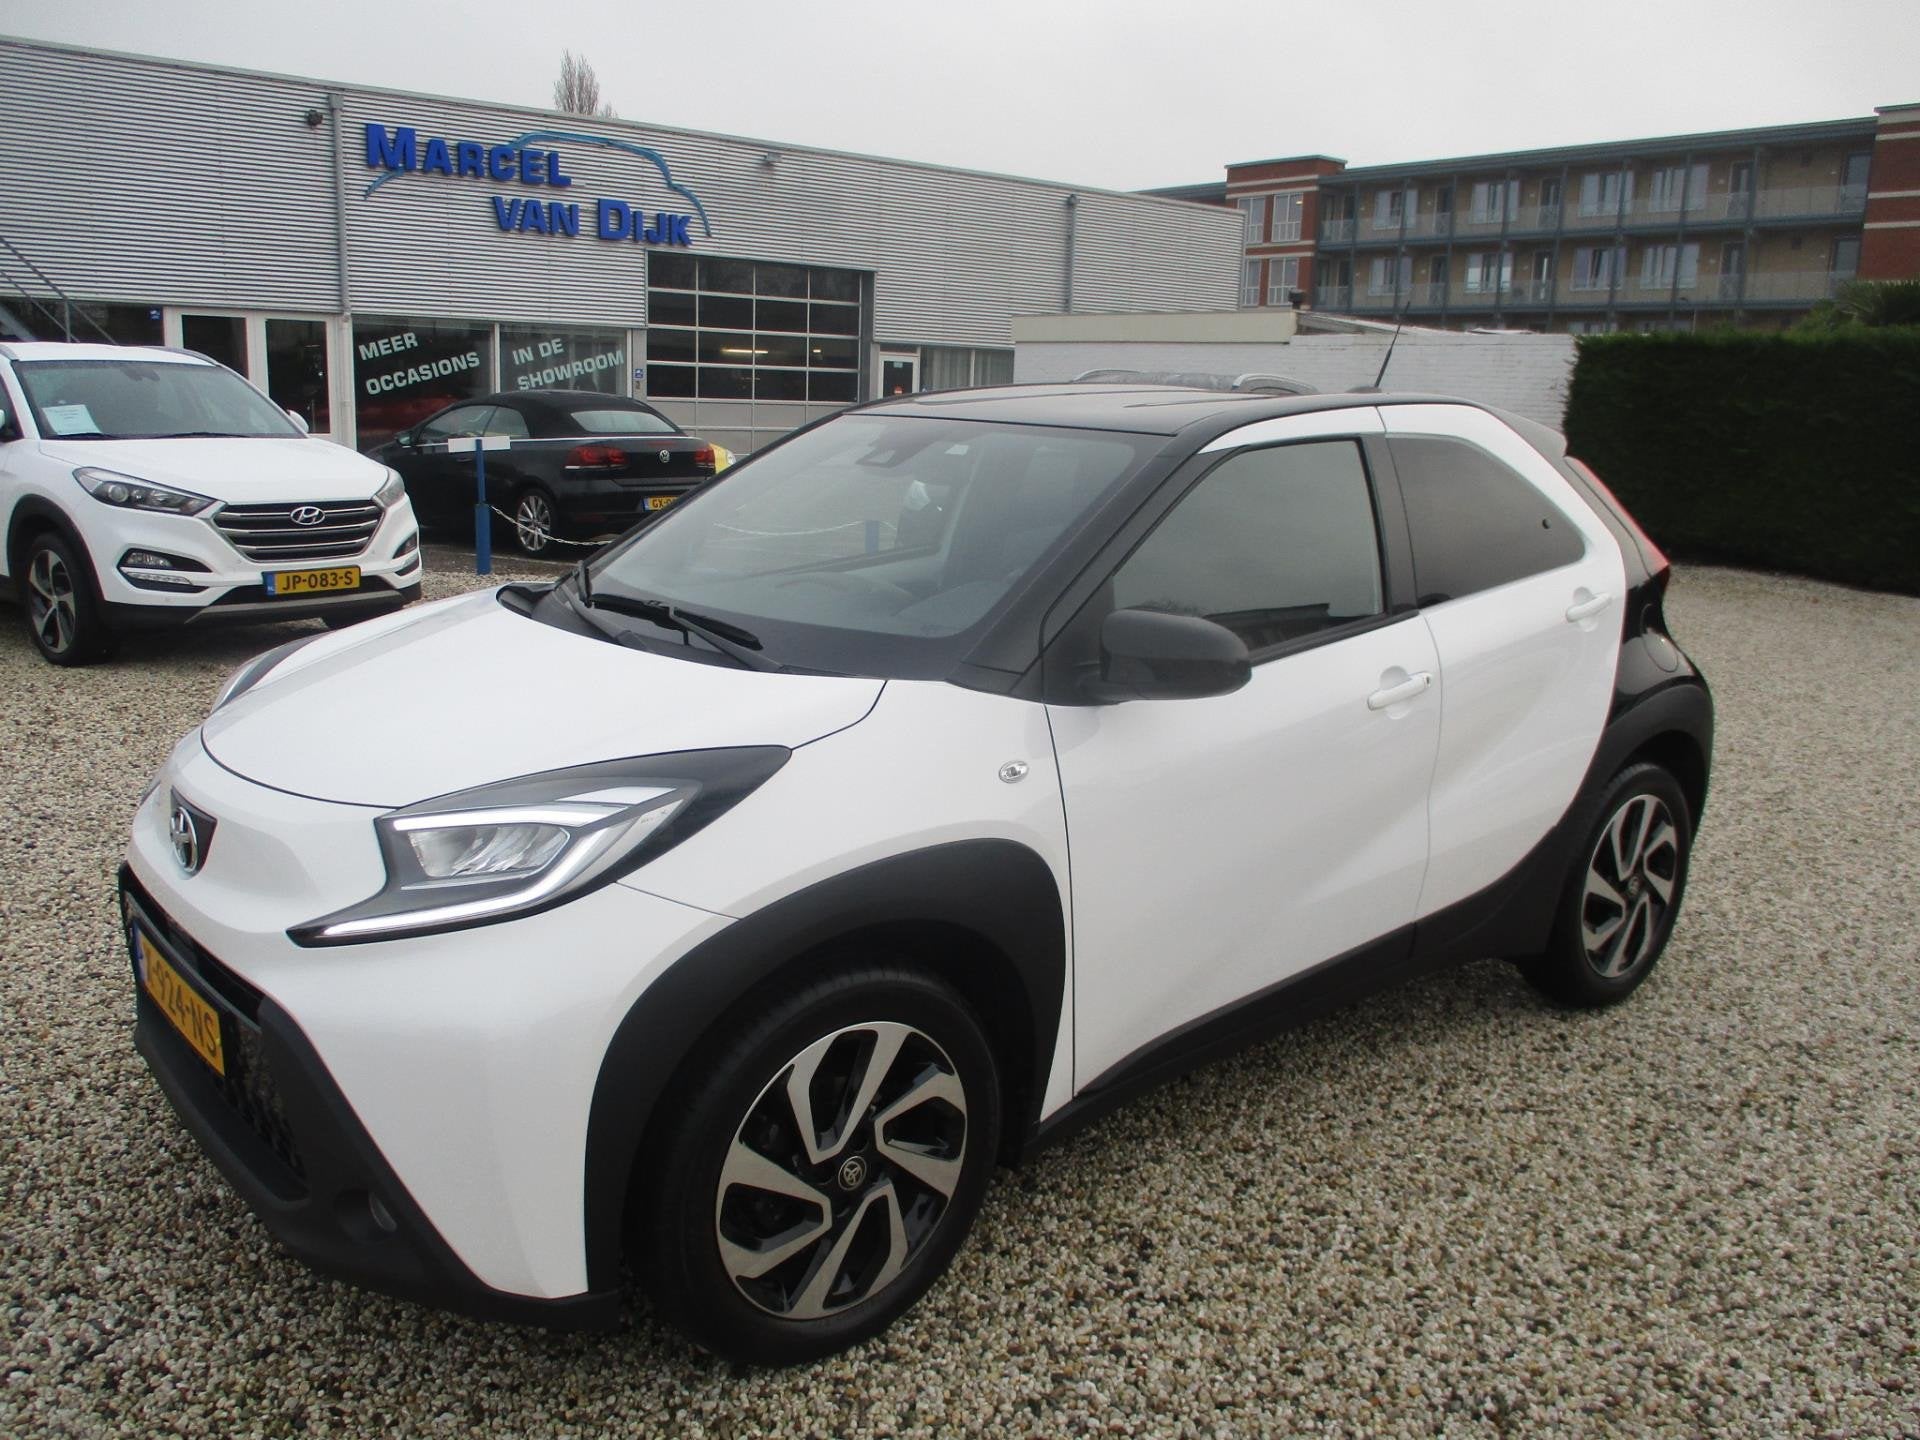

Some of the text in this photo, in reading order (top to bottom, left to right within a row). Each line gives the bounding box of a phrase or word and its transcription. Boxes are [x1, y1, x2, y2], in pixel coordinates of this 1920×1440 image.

[365, 123, 572, 187] MARCEL
[492, 196, 692, 246] VAN DIJK
[359, 332, 418, 360] MEER
[512, 338, 564, 365] IN DE
[366, 352, 480, 396] OCCASIONS
[517, 350, 624, 391] SHOWROOM
[282, 571, 353, 591] JP-083-S
